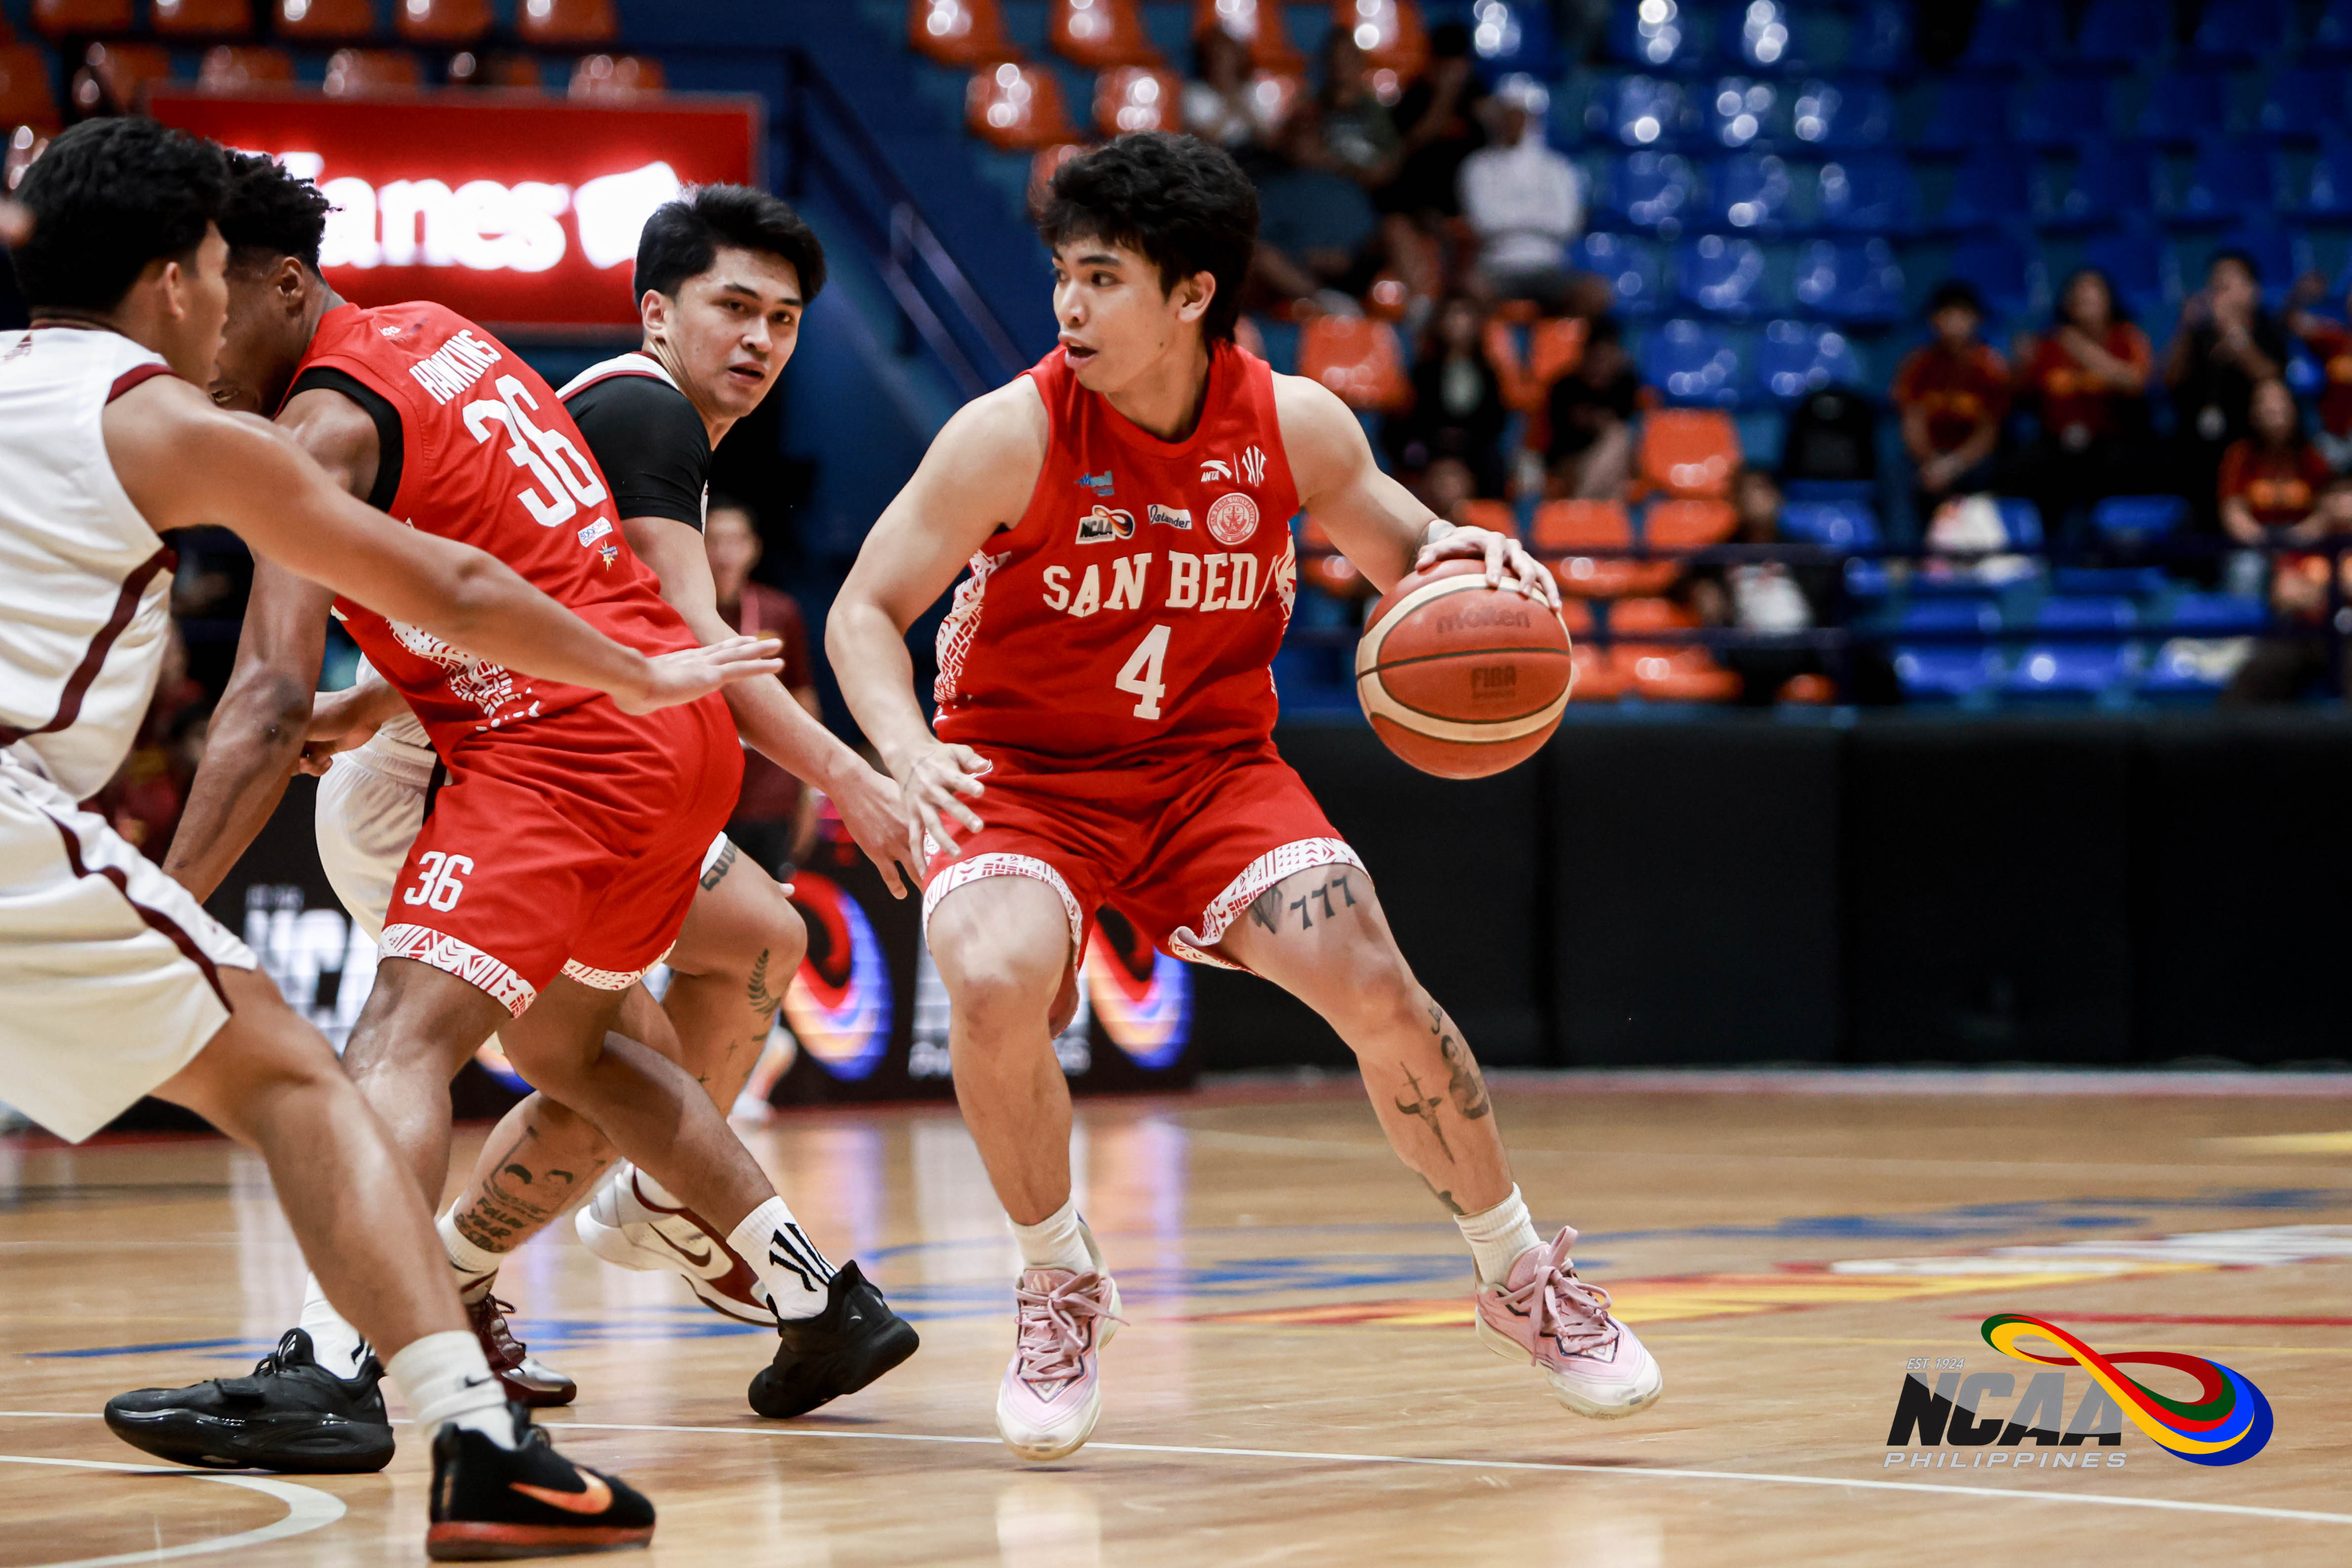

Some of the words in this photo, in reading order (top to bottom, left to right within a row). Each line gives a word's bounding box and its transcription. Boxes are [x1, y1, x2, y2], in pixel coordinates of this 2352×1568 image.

[409, 329, 502, 405] HAWKINS
[462, 374, 608, 527] 36
[1079, 518, 1113, 538] NCAA
[1150, 505, 1191, 528] Islander
[1043, 552, 1152, 617] SAN
[1437, 606, 1531, 634] molten
[1115, 624, 1171, 720] 4
[403, 850, 474, 913] 36
[1290, 875, 1357, 930] 777
